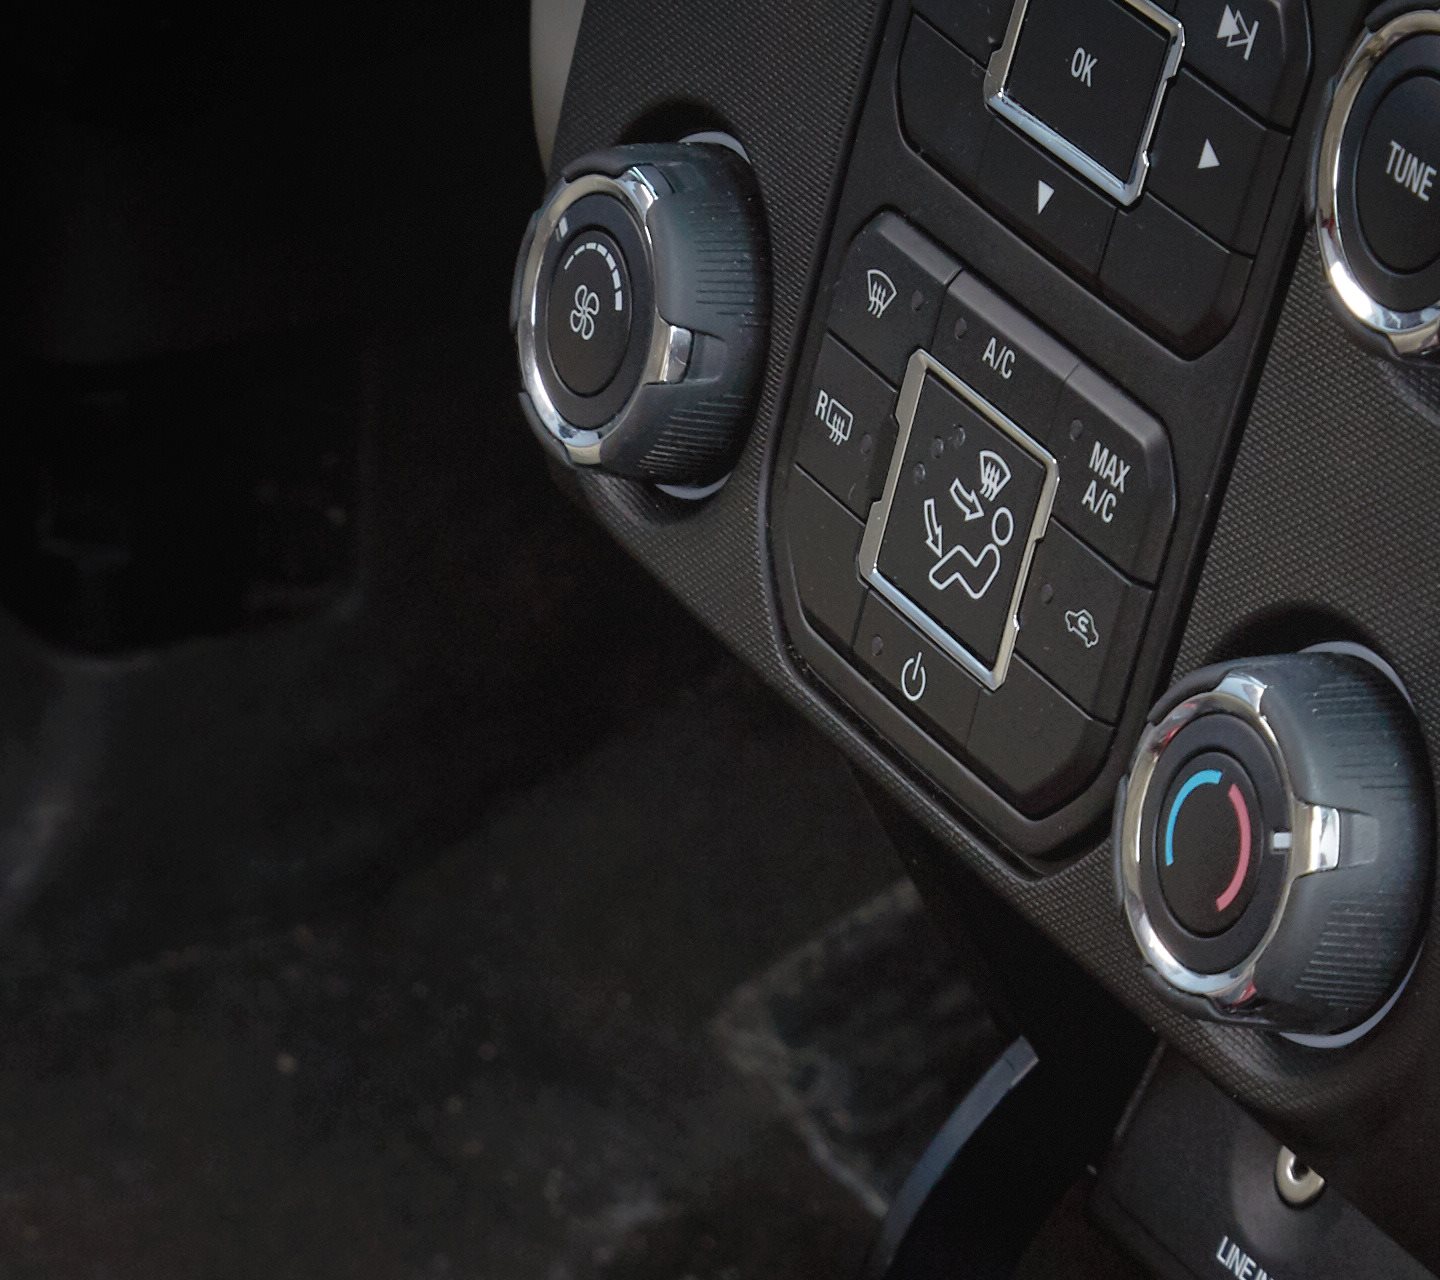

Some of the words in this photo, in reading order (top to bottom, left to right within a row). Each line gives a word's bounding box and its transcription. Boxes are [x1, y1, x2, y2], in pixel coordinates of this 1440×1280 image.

[1071, 47, 1098, 87] OK
[1386, 140, 1437, 201] TUNE
[982, 337, 1015, 379] A/C
[815, 389, 828, 420] R
[1089, 441, 1131, 493] MAX
[1082, 480, 1117, 523] A/C
